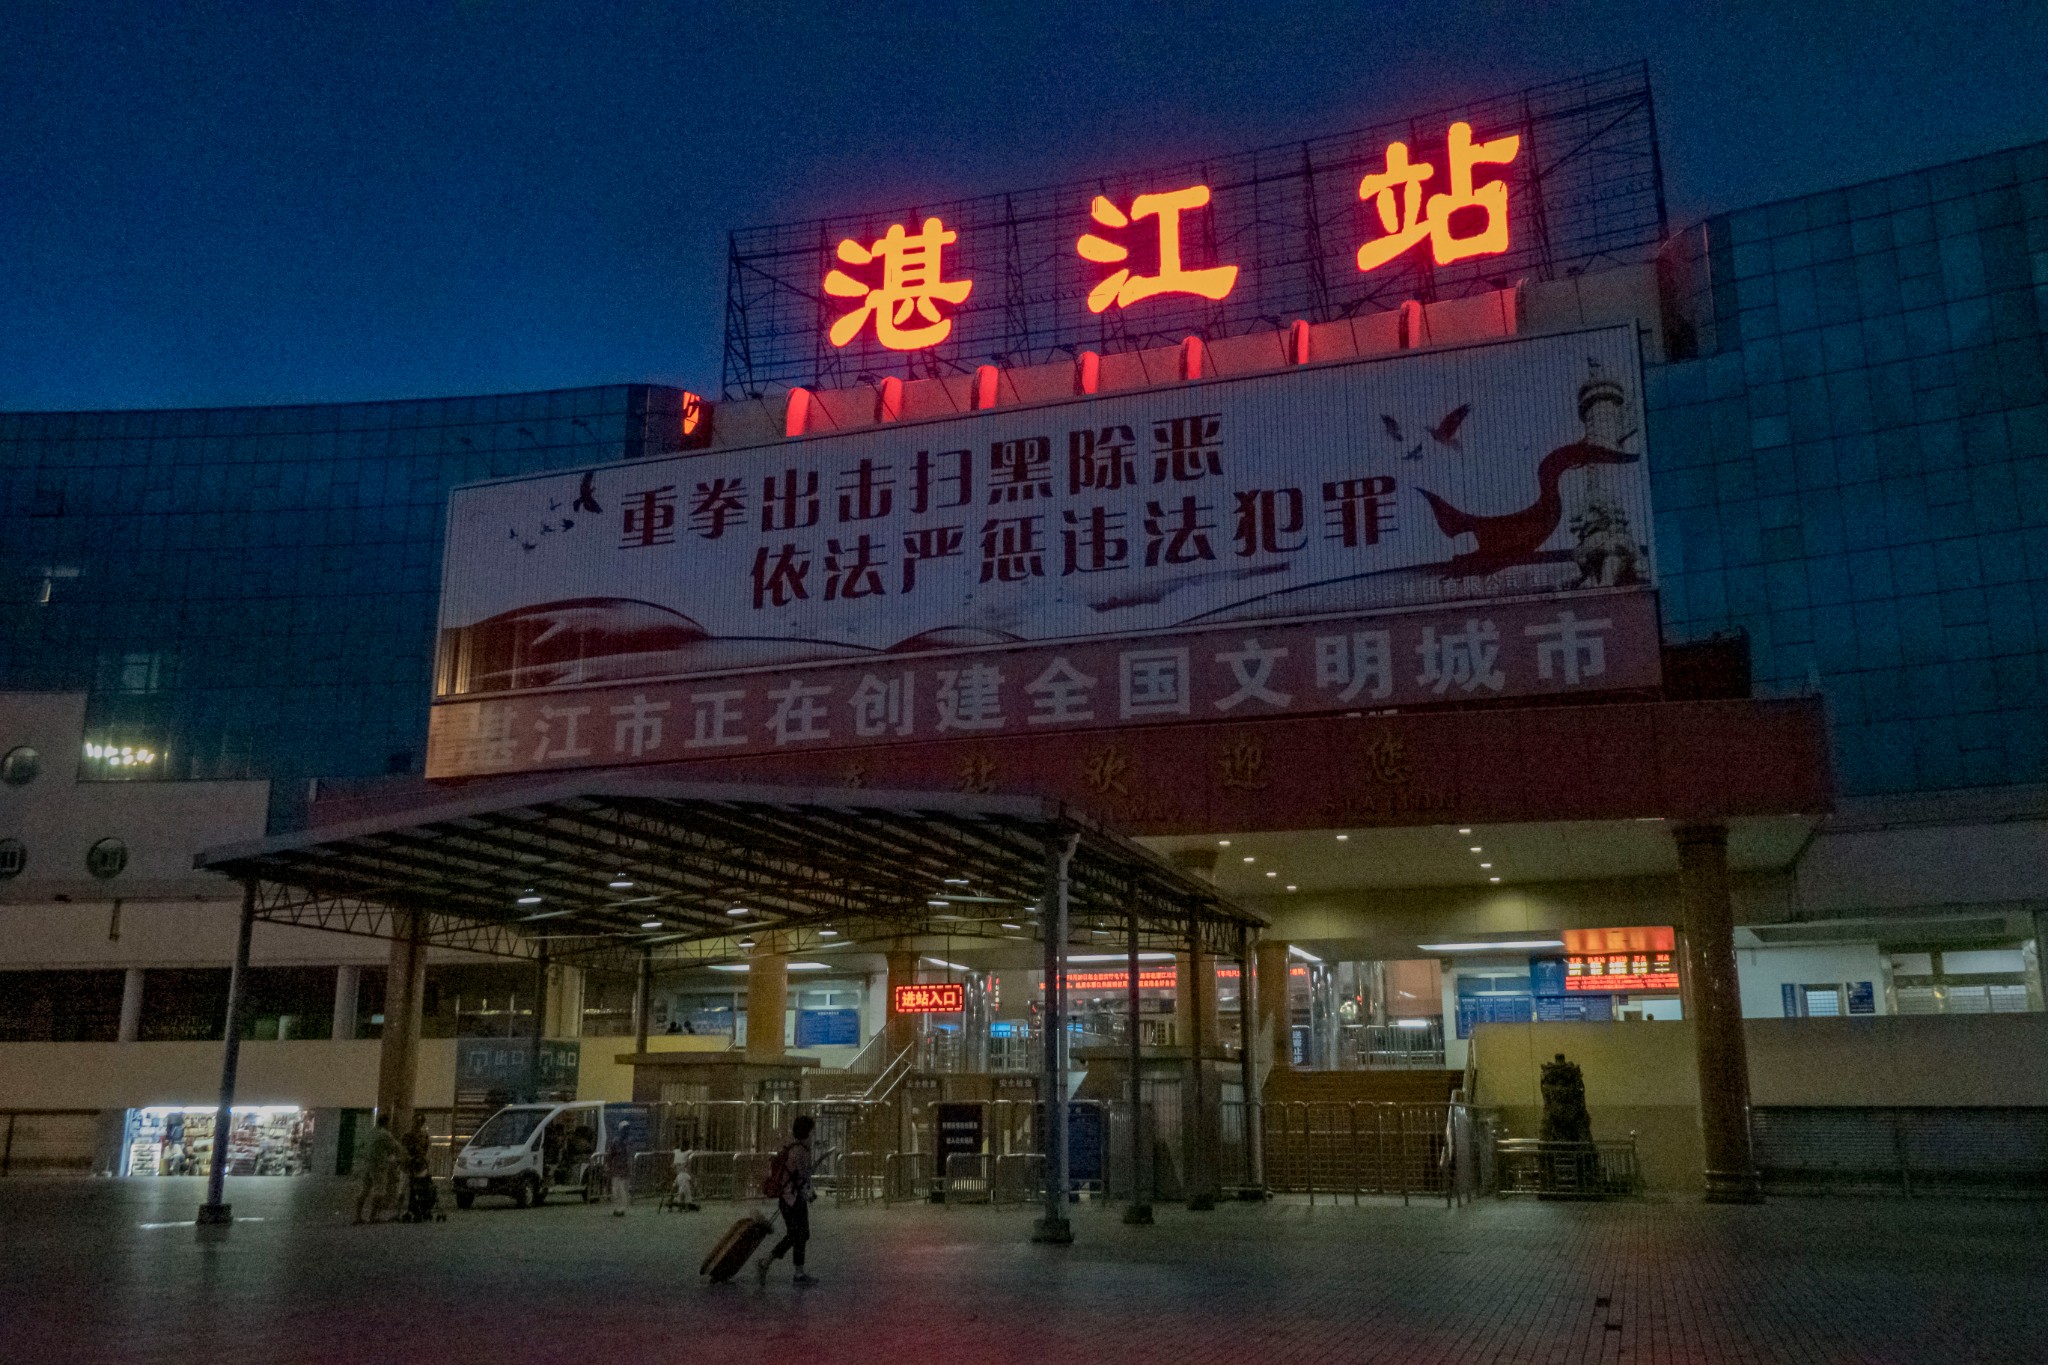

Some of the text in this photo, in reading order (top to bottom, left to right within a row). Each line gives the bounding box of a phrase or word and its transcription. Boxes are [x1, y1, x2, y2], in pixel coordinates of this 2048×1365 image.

[823, 121, 1522, 352] 湛江站
[618, 412, 1223, 549] 重拳出击扫黑除恶
[751, 475, 1397, 609] 依法严惩违法犯罪
[901, 990, 957, 1007] 进站入口
